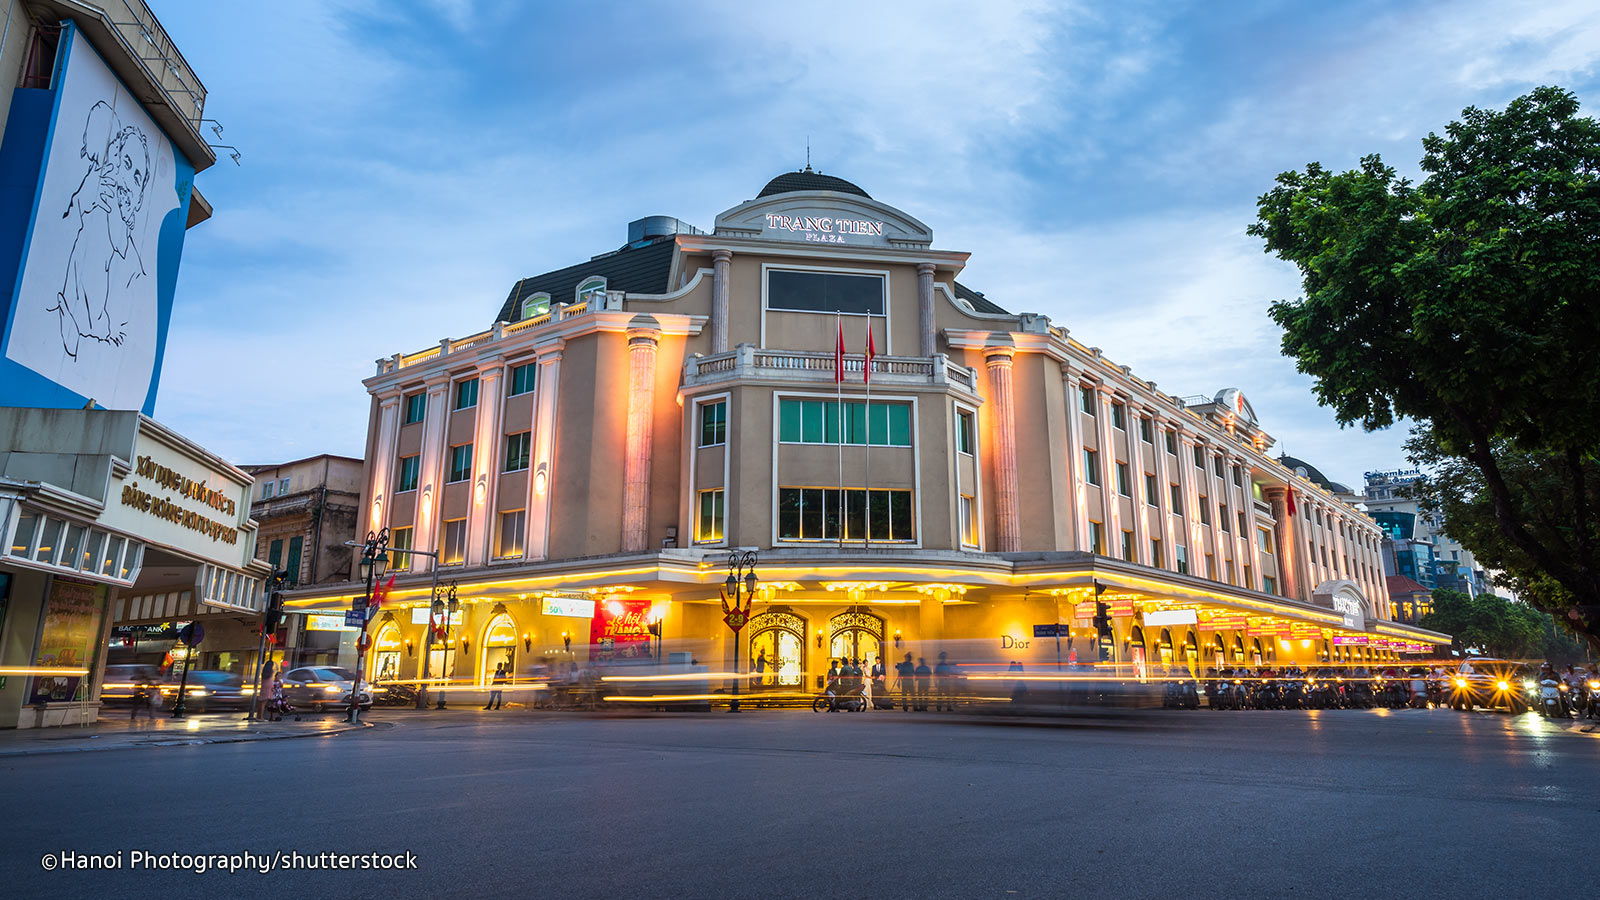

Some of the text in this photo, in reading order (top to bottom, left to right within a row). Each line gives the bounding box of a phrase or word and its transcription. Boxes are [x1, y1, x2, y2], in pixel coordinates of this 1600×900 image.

[766, 213, 883, 236] TRANG TIEN
[805, 232, 845, 243] PLAZA
[729, 614, 744, 624] 2-9
[1001, 635, 1030, 649] Dior
